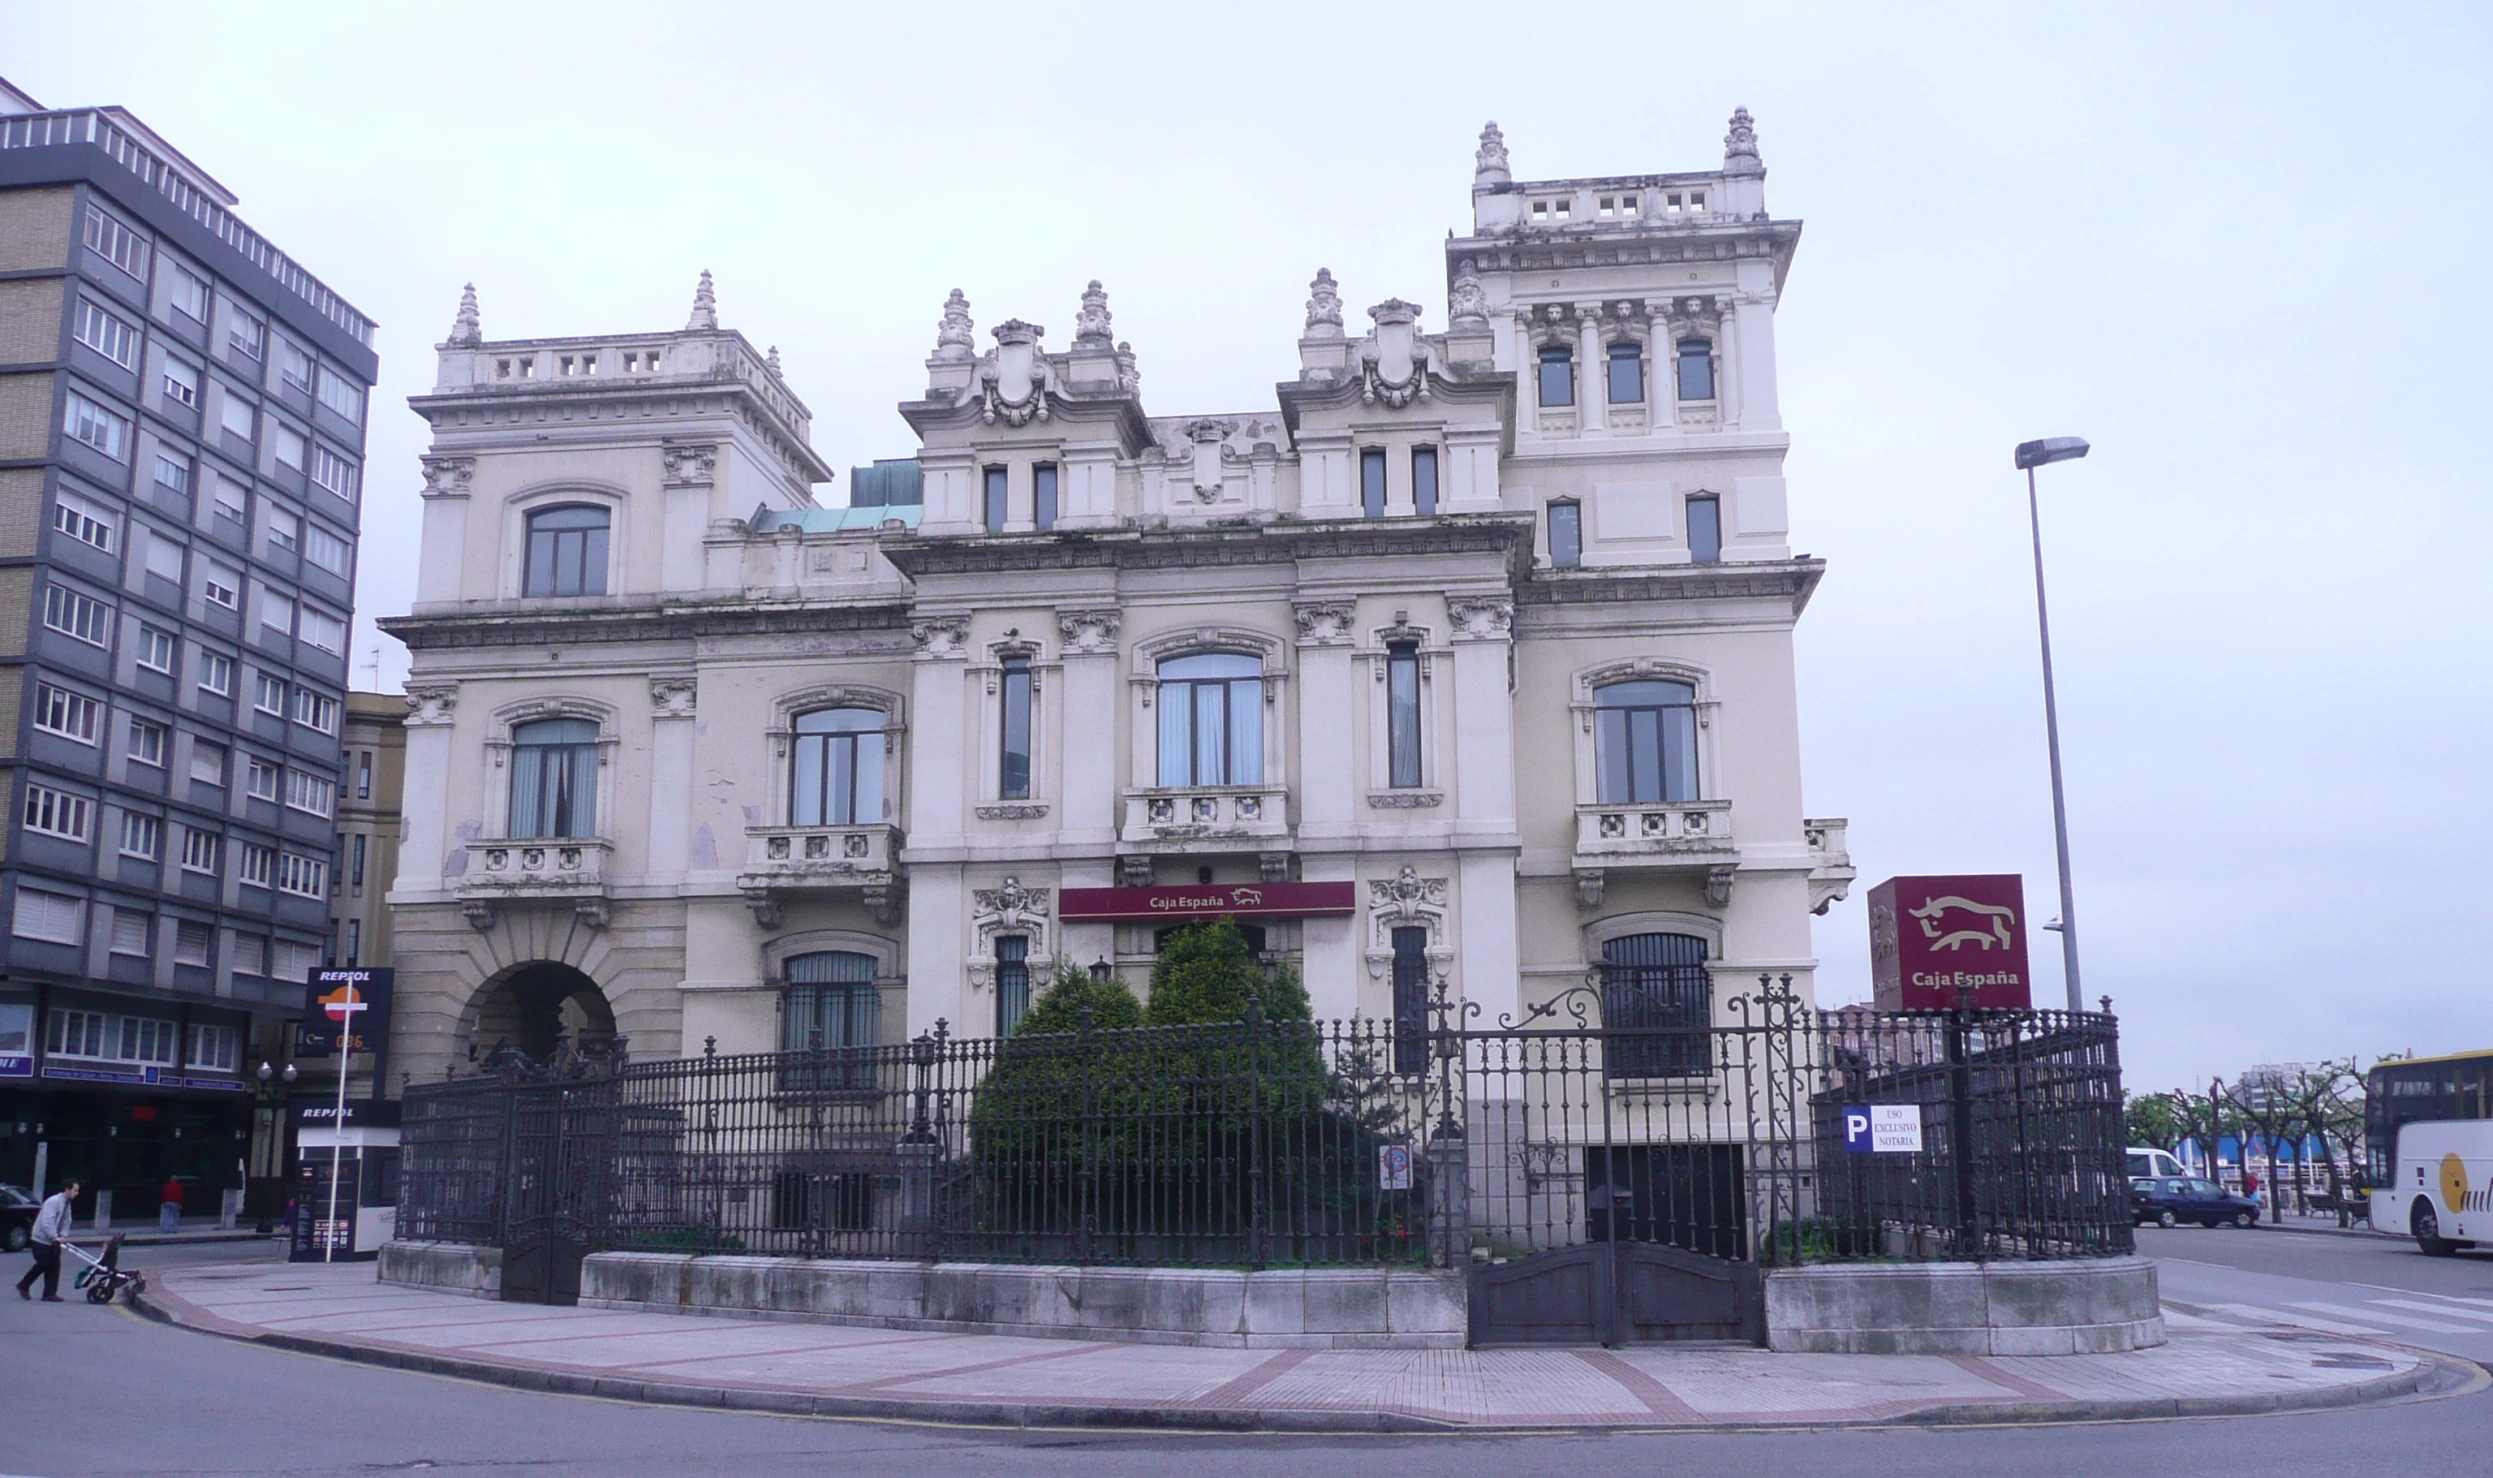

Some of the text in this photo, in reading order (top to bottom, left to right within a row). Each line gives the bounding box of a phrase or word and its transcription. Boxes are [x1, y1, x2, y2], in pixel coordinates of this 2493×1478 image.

[1150, 896, 1223, 910] Caja España
[1912, 971, 1951, 990] Caja
[1954, 971, 2020, 990] España
[1887, 1110, 1903, 1119] USO
[1848, 1115, 1868, 1142] P
[1874, 1123, 1917, 1132] EXCLUSIVO
